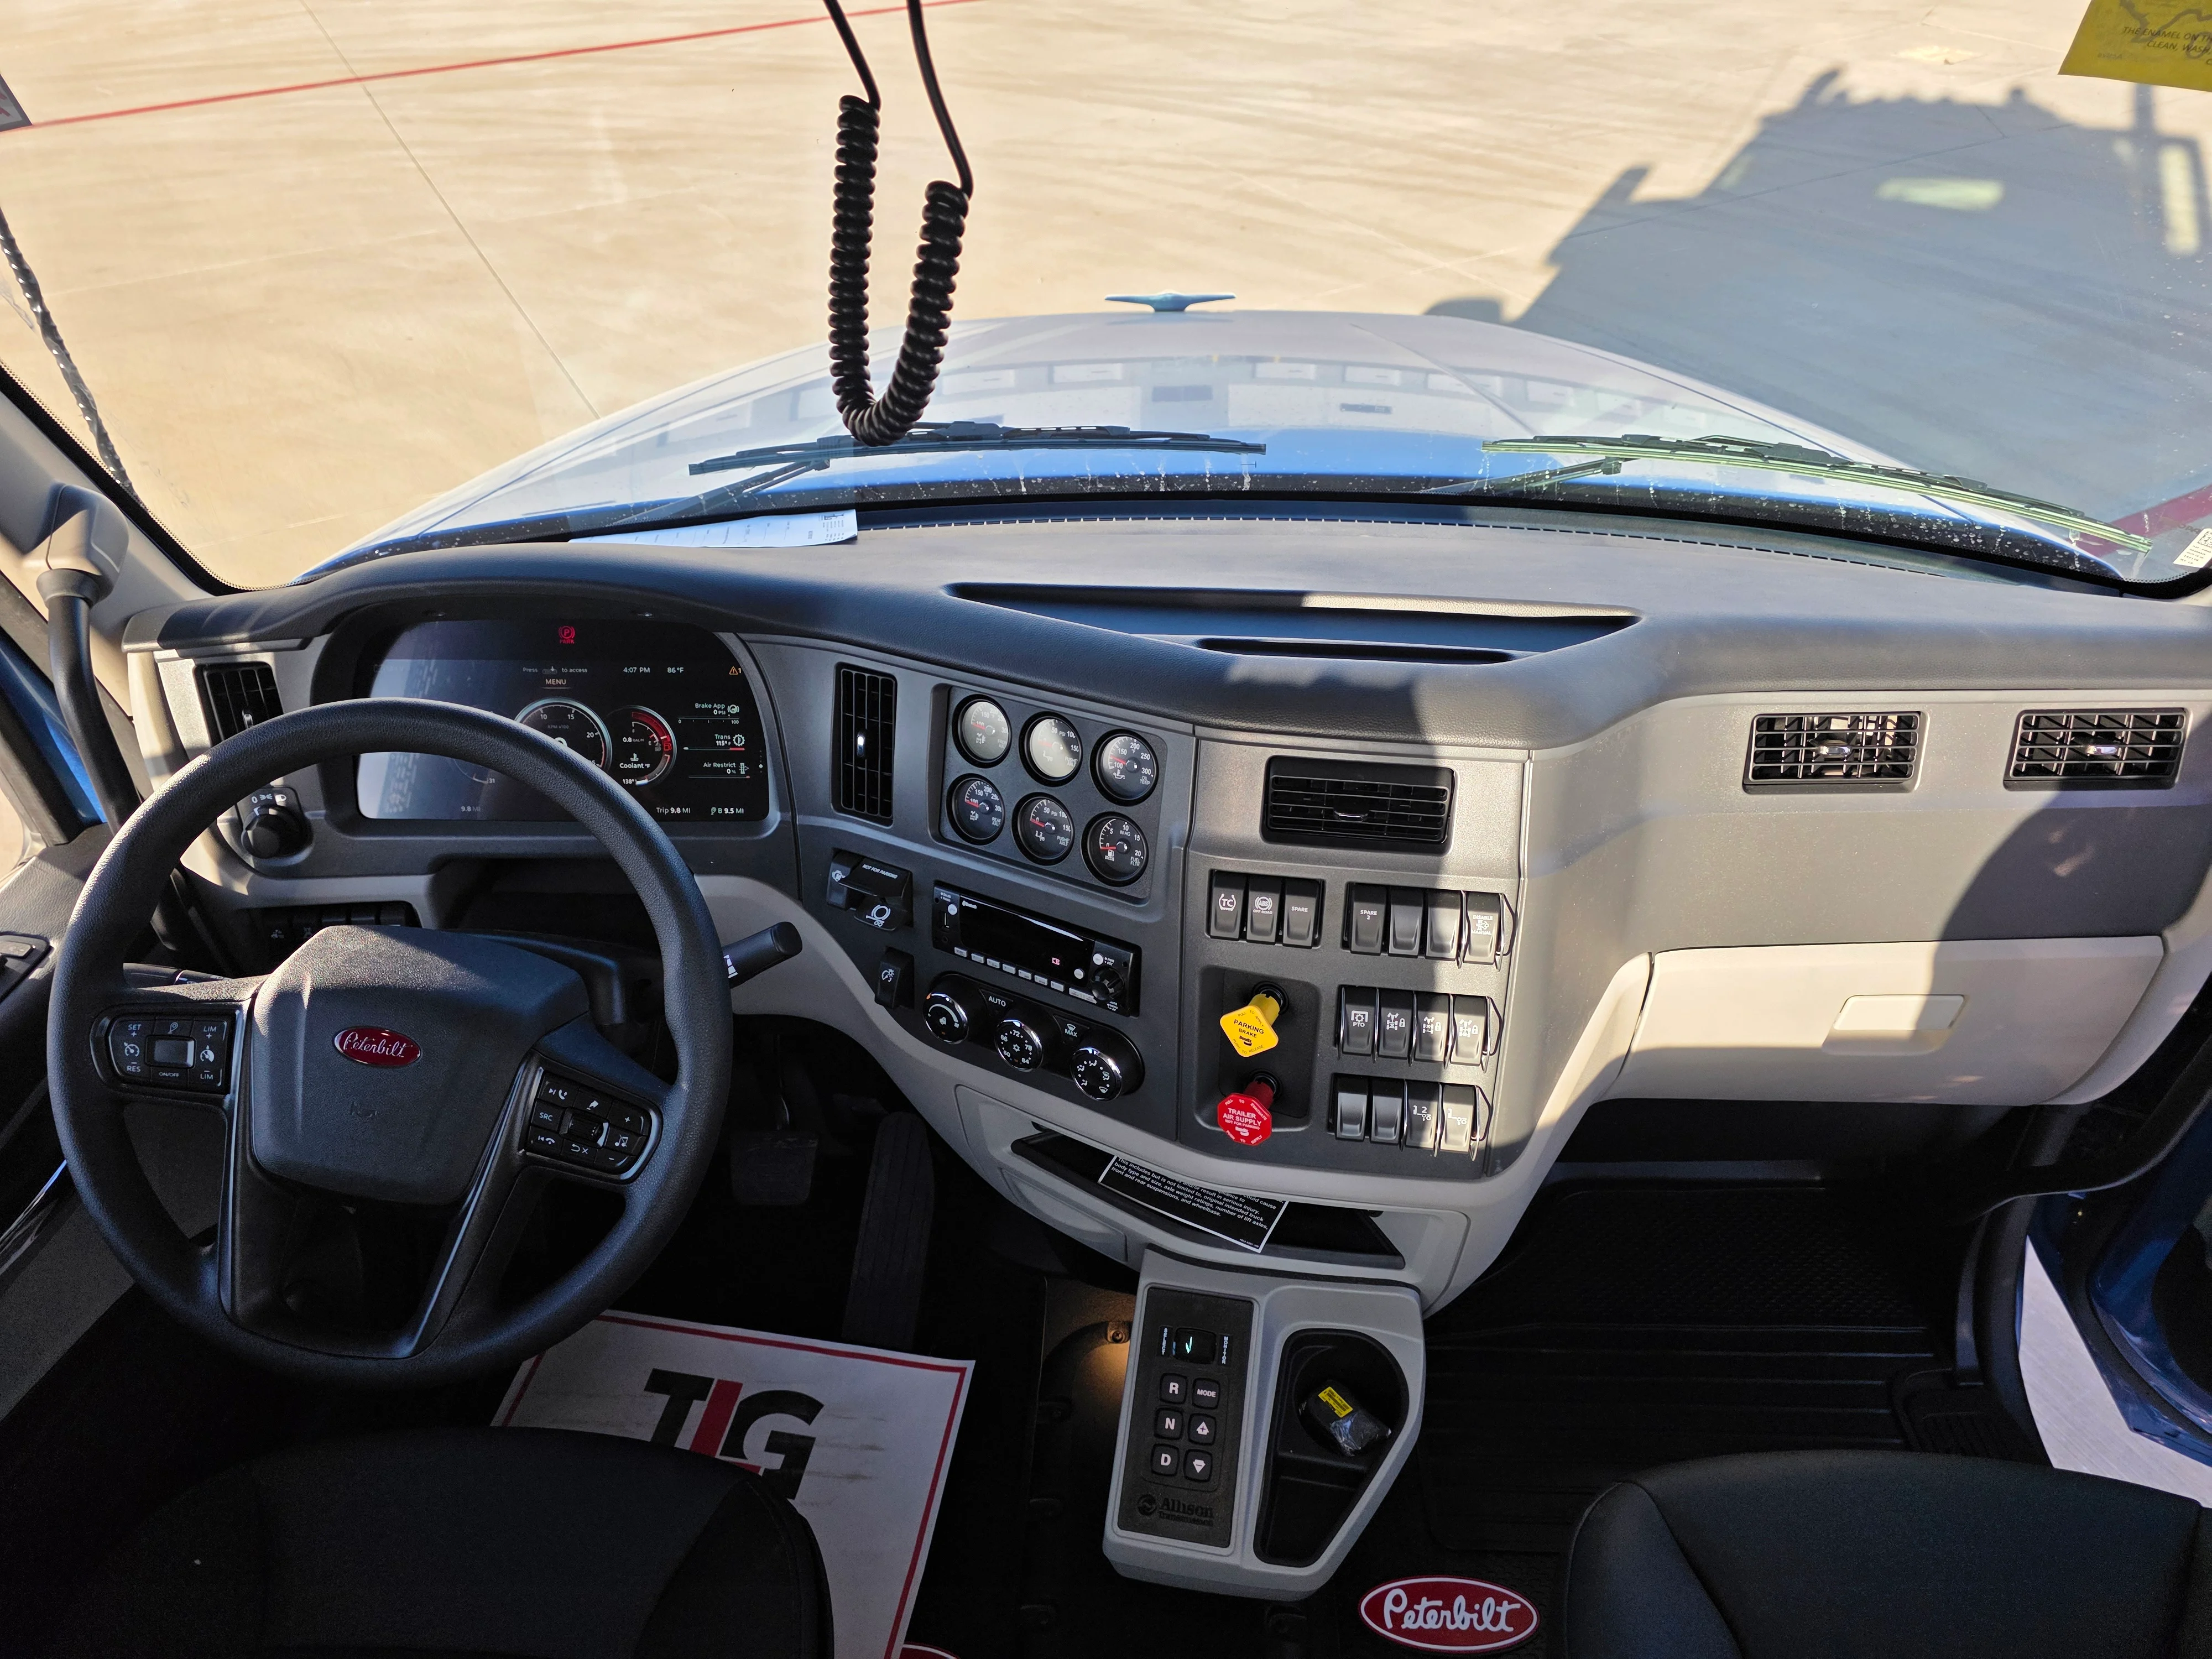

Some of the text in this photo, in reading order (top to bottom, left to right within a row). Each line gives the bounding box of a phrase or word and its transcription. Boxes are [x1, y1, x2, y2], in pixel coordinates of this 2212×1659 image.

[2122, 27, 2199, 41] THE ENAMEL ON
[2147, 40, 2178, 52] CLEAN,
[1118, 747, 1128, 755] 150
[1140, 752, 1150, 760] 250
[1114, 761, 1123, 769] 100
[1141, 767, 1151, 775] 300
[983, 785, 993, 794] 200
[1222, 898, 1234, 907] TC
[988, 995, 1006, 1007] AUTO
[1234, 1019, 1264, 1034] PARKING
[1255, 1016, 1265, 1027] APPLY
[1013, 1029, 1020, 1037] 72
[1065, 1029, 1078, 1038] MAX
[1238, 1028, 1258, 1038] BRAKE
[343, 1031, 414, 1058] Peterbilt
[1248, 1045, 1264, 1053] RELEASE
[539, 1112, 553, 1121] SRC
[1223, 1113, 1262, 1126] AIR SUPPLY
[1228, 1108, 1256, 1119] TRAILER
[1111, 1166, 1124, 1175] front
[1134, 1177, 1146, 1186] rear
[1146, 1183, 1180, 1201] suspensions,
[1192, 1202, 1221, 1217] wheelbase.
[1114, 1162, 1128, 1171] body
[1128, 1168, 1140, 1176] type
[1150, 1179, 1162, 1188] size,
[1176, 1190, 1193, 1199] weight
[1194, 1197, 1214, 1208] ratings,
[1215, 1206, 1237, 1216] number
[1252, 1220, 1268, 1230] axles,
[1129, 1162, 1151, 1175] includes
[1151, 1172, 1161, 1180] but
[1176, 1183, 1195, 1194] limited
[1203, 1196, 1224, 1206] original
[1224, 1202, 1249, 1215] intended
[1249, 1213, 1264, 1222] truck
[1201, 1188, 1216, 1197] result
[1223, 1197, 1243, 1207] serious
[1243, 1204, 1260, 1215] injury.
[1260, 1201, 1276, 1209] cause
[1169, 1382, 1217, 1397] R MODE
[1165, 1417, 1175, 1430] N
[1160, 1453, 1171, 1466] D
[1161, 1498, 1214, 1517] Allison
[1383, 1588, 1521, 1632] Peterbilt
